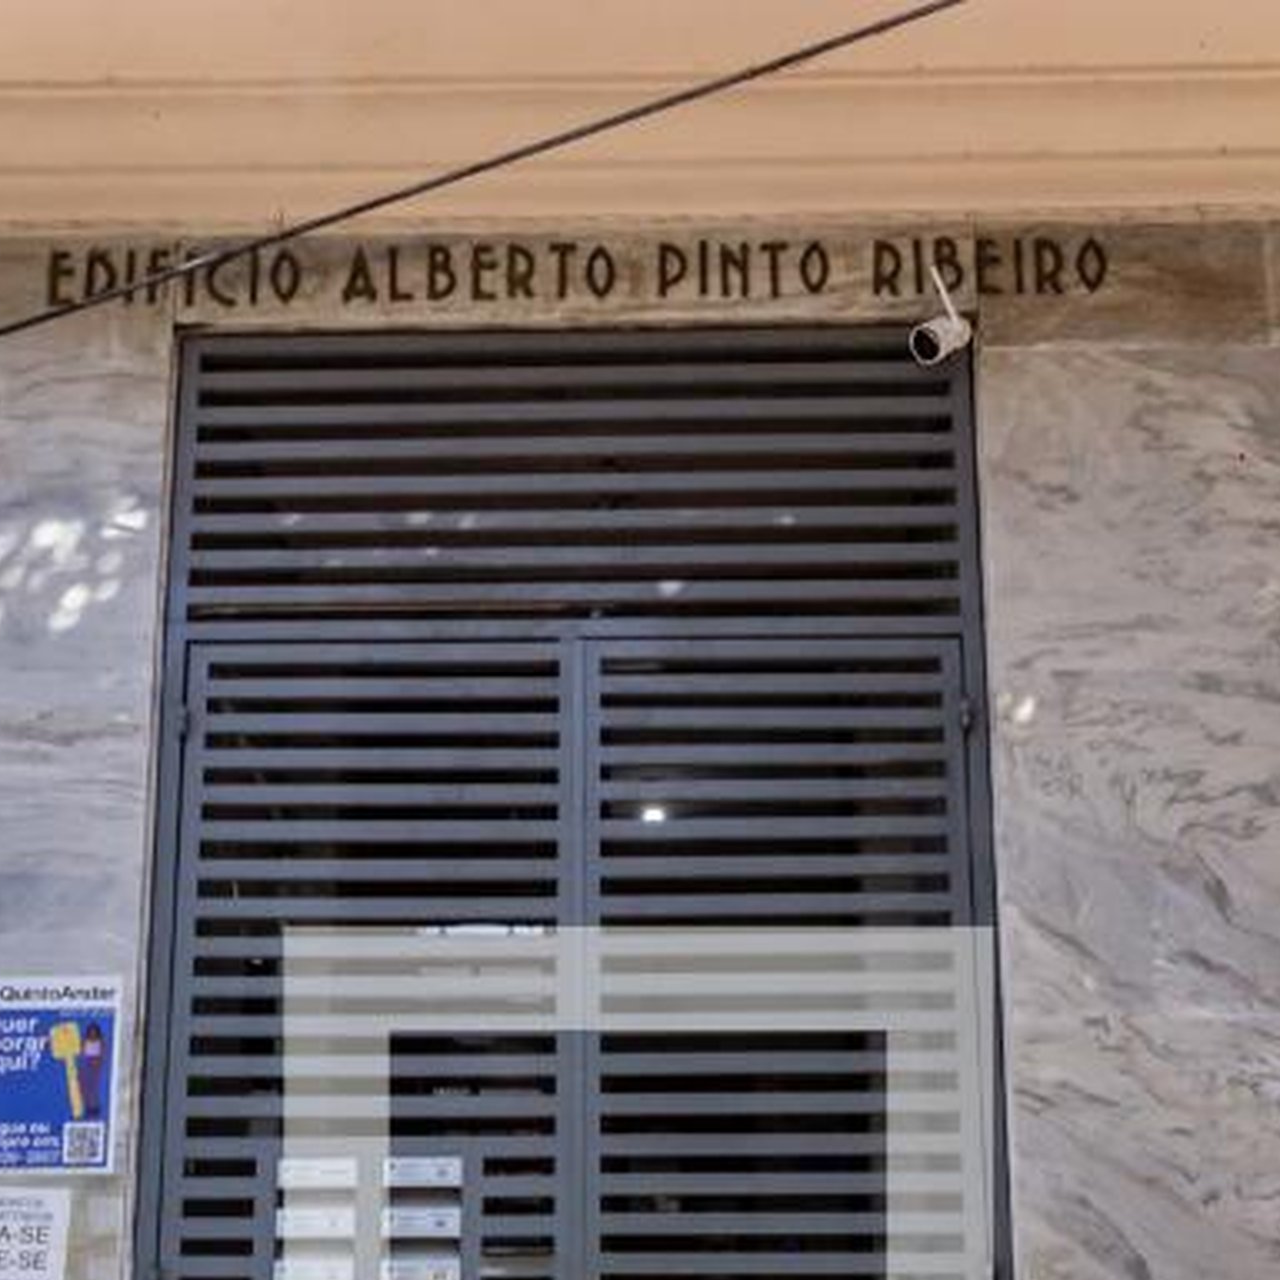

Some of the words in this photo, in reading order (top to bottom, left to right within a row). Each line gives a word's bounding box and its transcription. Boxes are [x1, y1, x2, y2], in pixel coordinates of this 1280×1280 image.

[48, 246, 302, 307] EDIFICIO
[341, 241, 617, 304] ALBERTO
[656, 239, 830, 298] PINTO
[871, 235, 1108, 298] RIBEIRO
